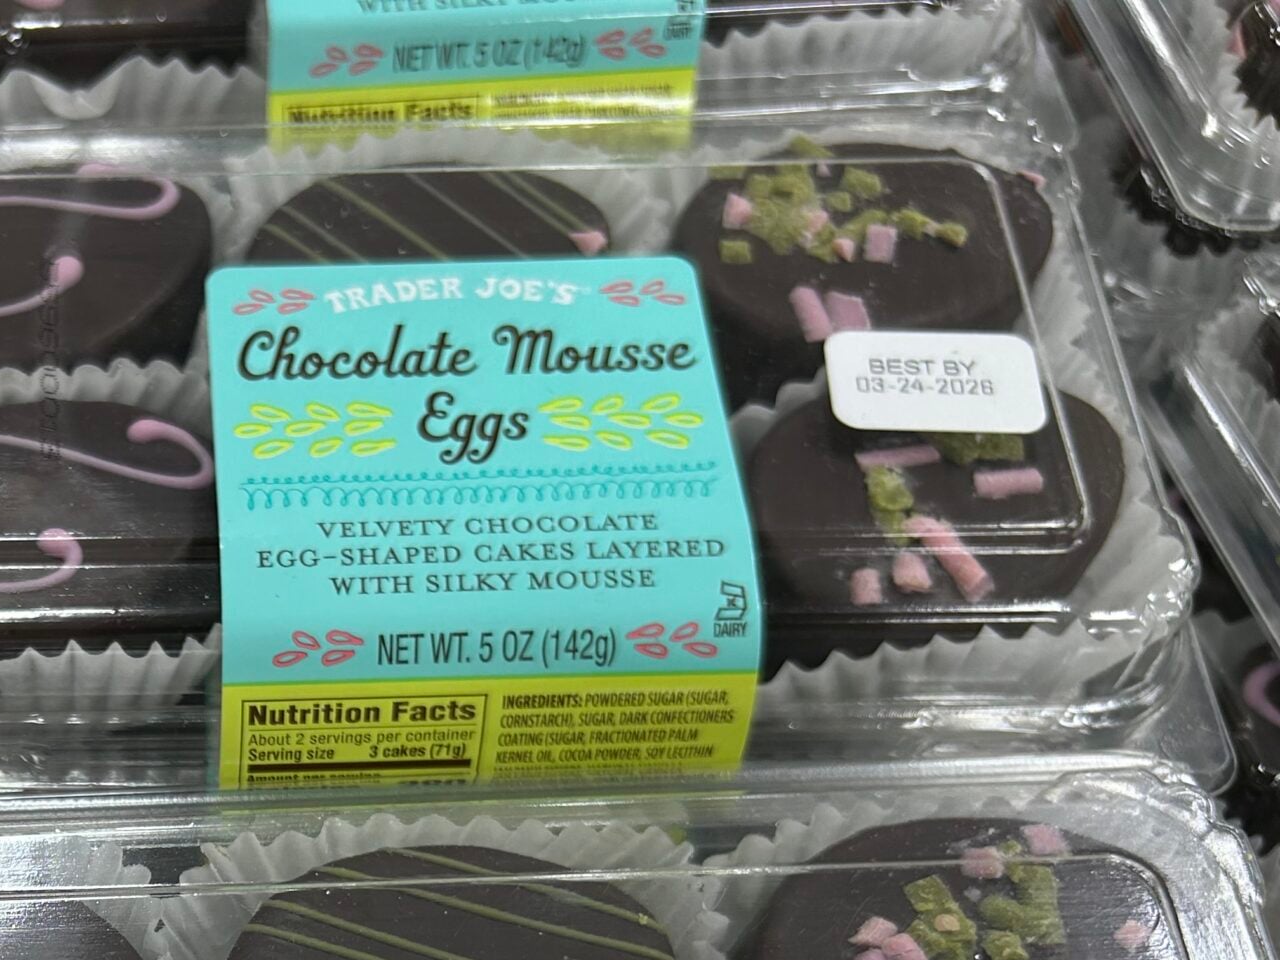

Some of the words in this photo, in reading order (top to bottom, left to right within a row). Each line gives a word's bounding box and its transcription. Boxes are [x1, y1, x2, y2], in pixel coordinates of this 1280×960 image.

[323, 277, 463, 314] TRADER
[235, 324, 478, 382] Chocolate
[491, 325, 699, 375] Mousse
[869, 358, 935, 376] BEST
[942, 360, 977, 376] BY
[417, 390, 529, 464] Eggs
[316, 519, 454, 539] VELVETY
[464, 513, 659, 537] CHOCOLATE
[256, 544, 462, 568] EGG-SHAPED
[474, 542, 576, 563] CAKES
[586, 538, 725, 560] LAYERED
[329, 576, 414, 596] WITH
[425, 572, 518, 593] SILKY
[526, 569, 656, 590] MOUSSE
[713, 621, 747, 638] DAIRY
[375, 632, 424, 665] NET
[431, 631, 471, 664] WT.
[478, 632, 492, 662] 5
[501, 631, 535, 661] OZ
[540, 629, 617, 667] (142g)
[248, 702, 380, 726] Nutrition
[391, 701, 476, 722] Facts
[248, 734, 291, 746] About
[296, 733, 305, 744] 2
[310, 731, 371, 745] servings
[376, 731, 401, 744] per
[405, 729, 476, 742] container
[248, 749, 301, 763] Serving
[307, 748, 335, 760] size
[369, 746, 378, 758] 3
[383, 745, 426, 758] cakes
[429, 743, 466, 760] (71g)
